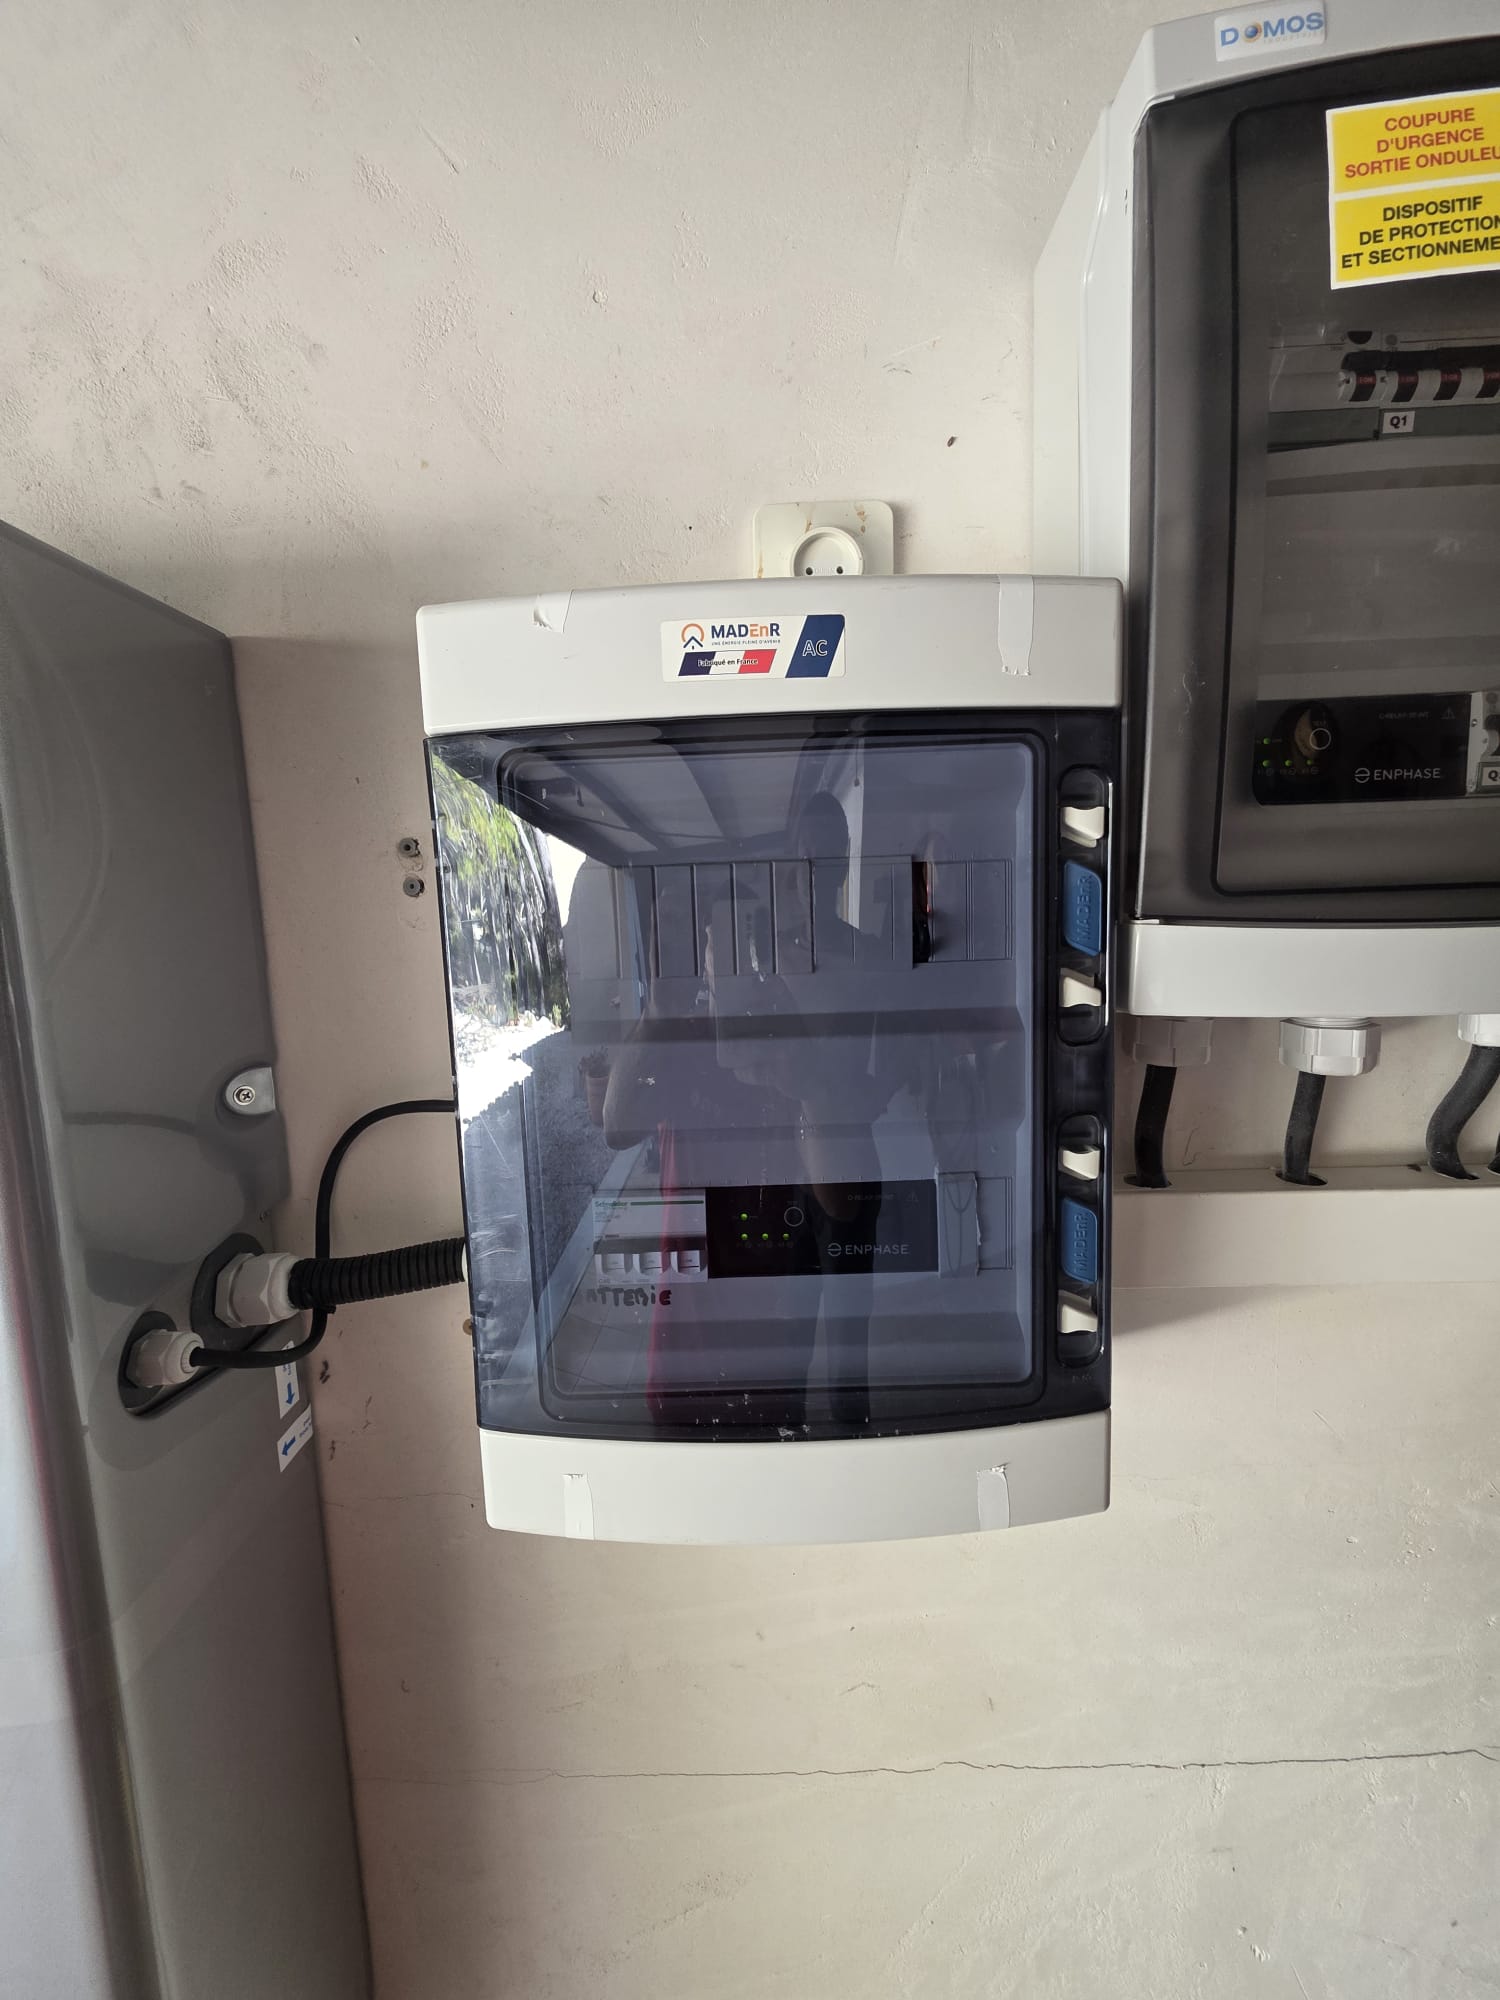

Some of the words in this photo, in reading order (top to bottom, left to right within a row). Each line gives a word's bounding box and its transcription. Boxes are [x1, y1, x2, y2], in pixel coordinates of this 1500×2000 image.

[1385, 107, 1475, 131] COUPURE
[1377, 127, 1484, 153] D'URGENCE
[1345, 152, 1410, 179] SORTIE
[1383, 196, 1483, 222] DISPOSITIF
[1359, 230, 1384, 246] DE
[1342, 252, 1364, 269] ET
[1368, 236, 1500, 265] SECTIONNEME
[1389, 415, 1408, 429] Q1
[711, 623, 781, 639] MADEnR
[802, 640, 828, 657] AC
[697, 658, 726, 667] Fabriqué
[1374, 768, 1441, 781] ENPHASE
[1488, 770, 1500, 782] Q
[845, 1244, 909, 1256] ENPHASE
